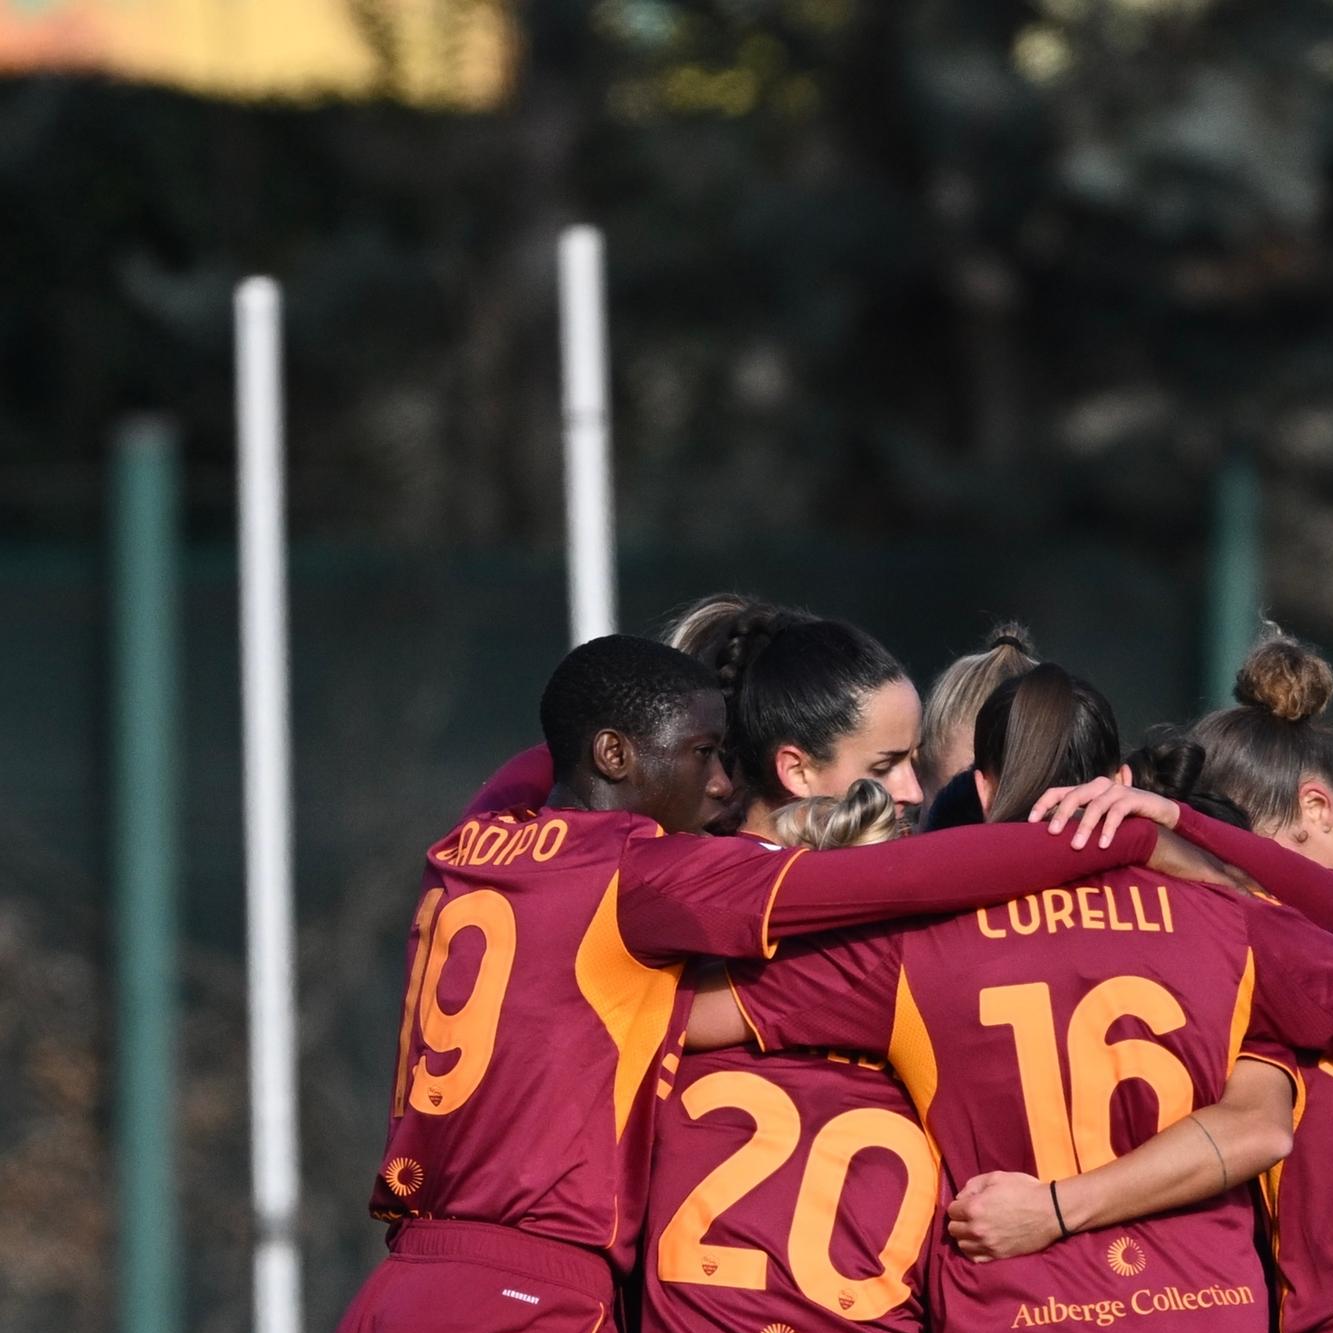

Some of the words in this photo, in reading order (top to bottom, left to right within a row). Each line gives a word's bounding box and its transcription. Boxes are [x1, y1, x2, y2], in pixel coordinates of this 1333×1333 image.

[393, 888, 516, 1117] 19
[979, 976, 1193, 1183] 16
[657, 1071, 936, 1321] 20
[1012, 1297, 1127, 1328] Auberge
[1131, 1285, 1255, 1315] Collection
